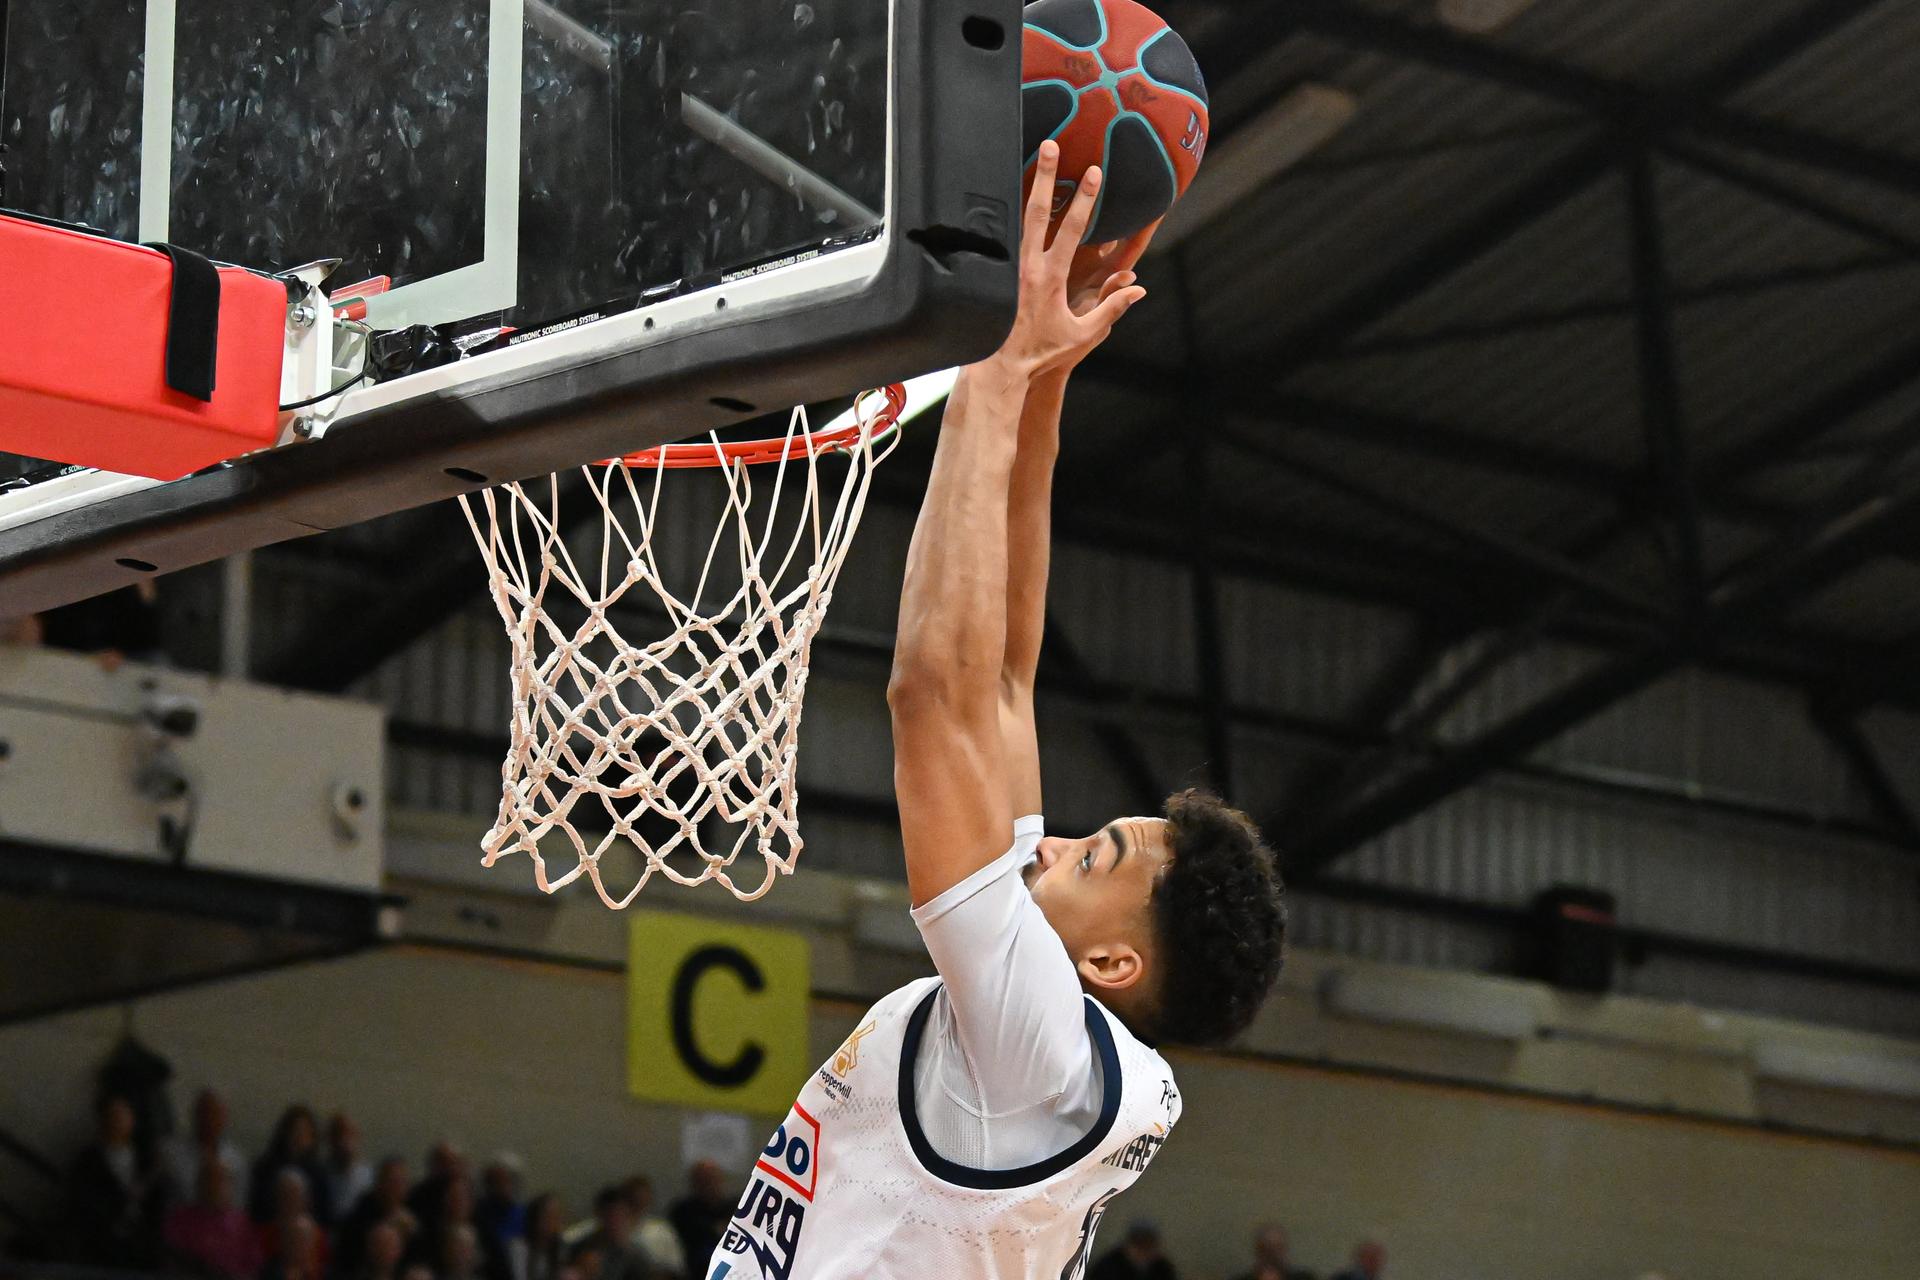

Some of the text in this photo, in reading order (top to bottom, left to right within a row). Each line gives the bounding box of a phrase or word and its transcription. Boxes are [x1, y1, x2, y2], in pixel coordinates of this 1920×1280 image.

[756, 255, 796, 274] SCOREBOARD
[796, 249, 819, 263] SYSTEM
[509, 312, 600, 345] NAUTRONIC SCOREBOARD SYSTEM
[671, 943, 766, 1090] C
